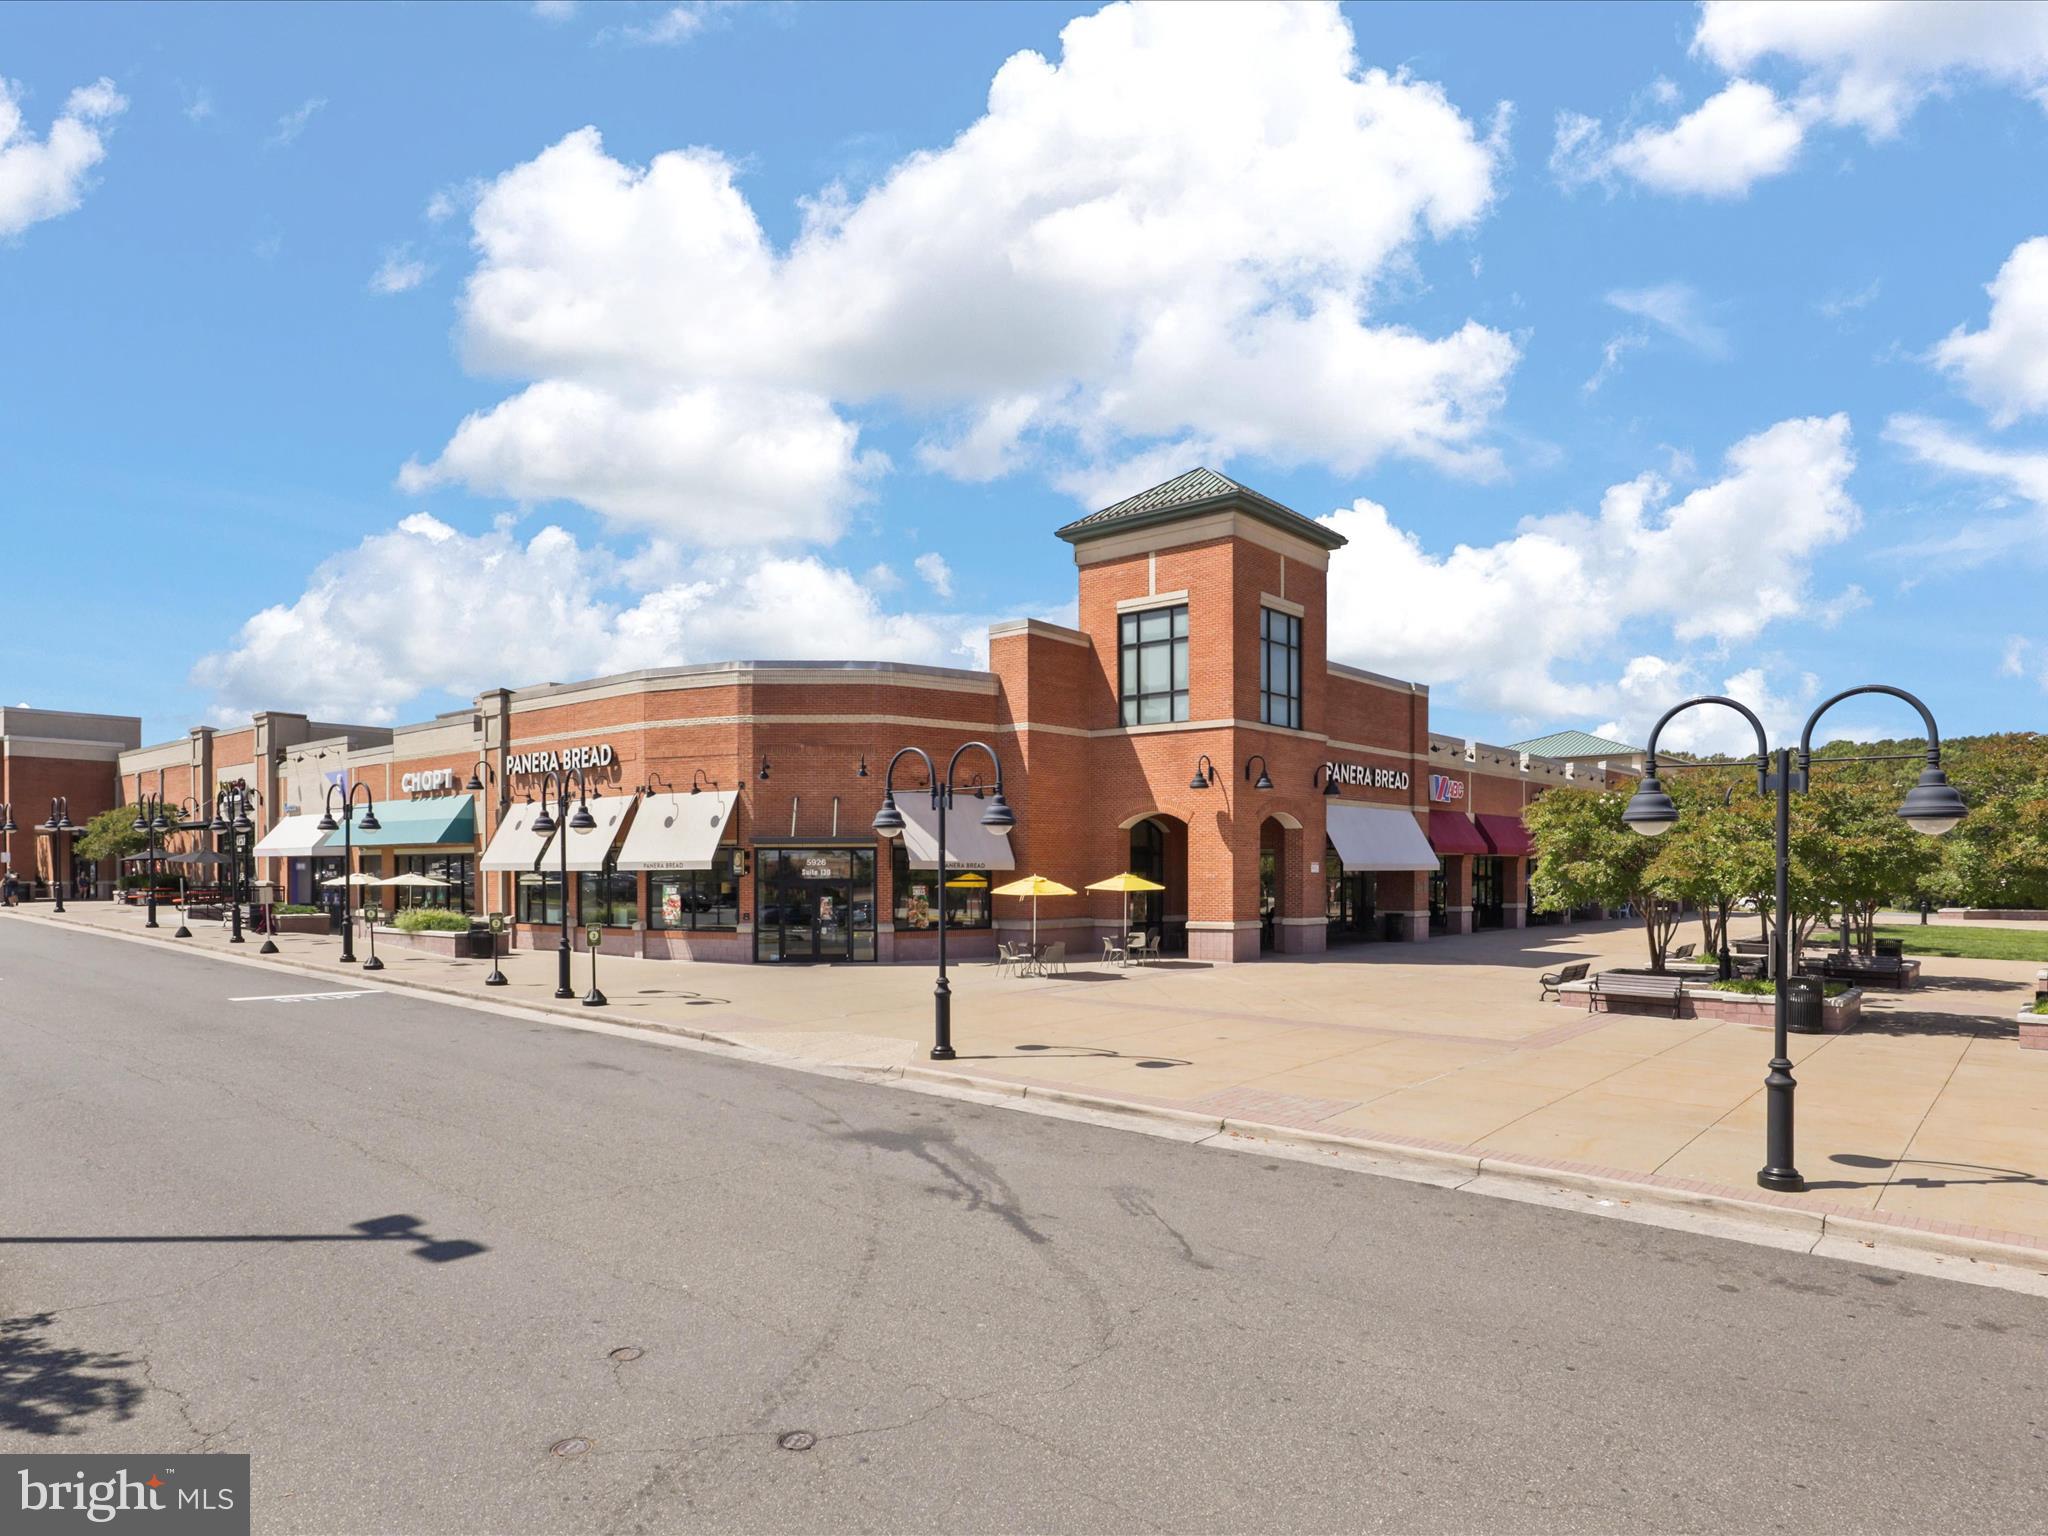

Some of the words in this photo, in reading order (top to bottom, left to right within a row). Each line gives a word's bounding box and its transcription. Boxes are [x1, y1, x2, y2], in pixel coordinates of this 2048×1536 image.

[506, 750, 560, 776] PANERA
[562, 744, 613, 770] BREAD
[401, 768, 454, 793] CHOPT
[1326, 761, 1372, 786] PANERA
[1374, 768, 1410, 790] BREAD
[801, 868, 818, 877] Suite
[806, 858, 827, 867] 5926
